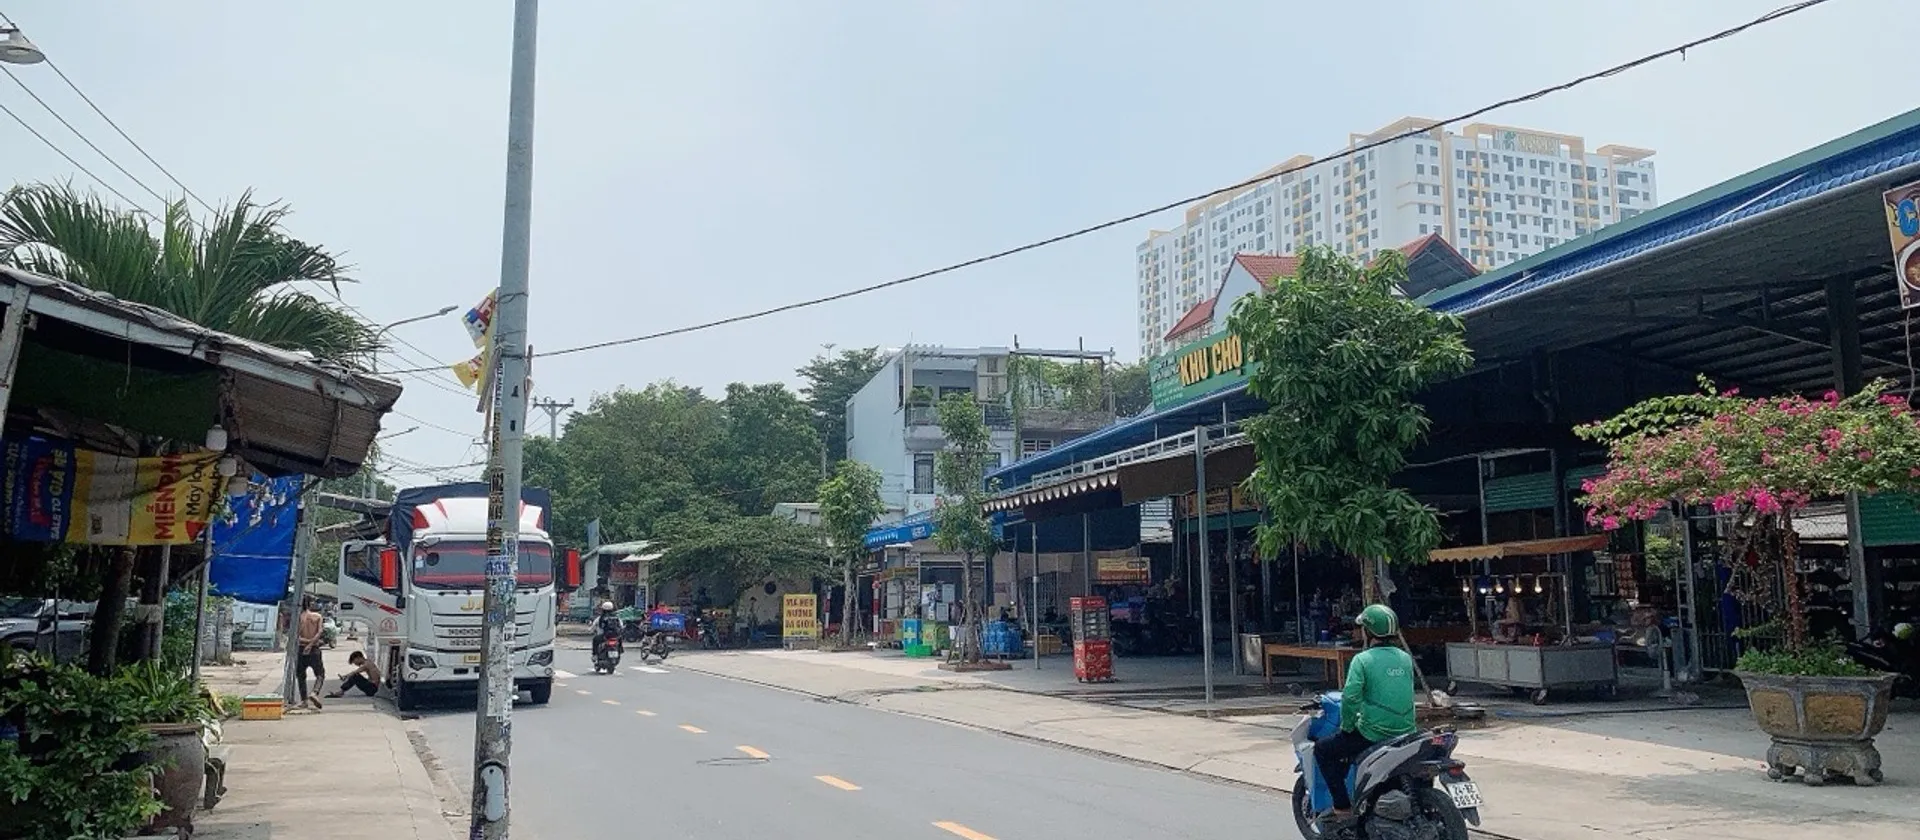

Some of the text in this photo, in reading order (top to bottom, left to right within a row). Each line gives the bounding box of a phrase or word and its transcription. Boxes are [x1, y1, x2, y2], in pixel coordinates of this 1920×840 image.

[1180, 348, 1208, 387] KHU
[48, 470, 66, 497] GIÁ
[51, 497, 62, 513] TO
[186, 484, 204, 515] Máy
[145, 487, 175, 540] MIỄN
[50, 514, 62, 541] SALE
[1386, 667, 1405, 677] Grab
